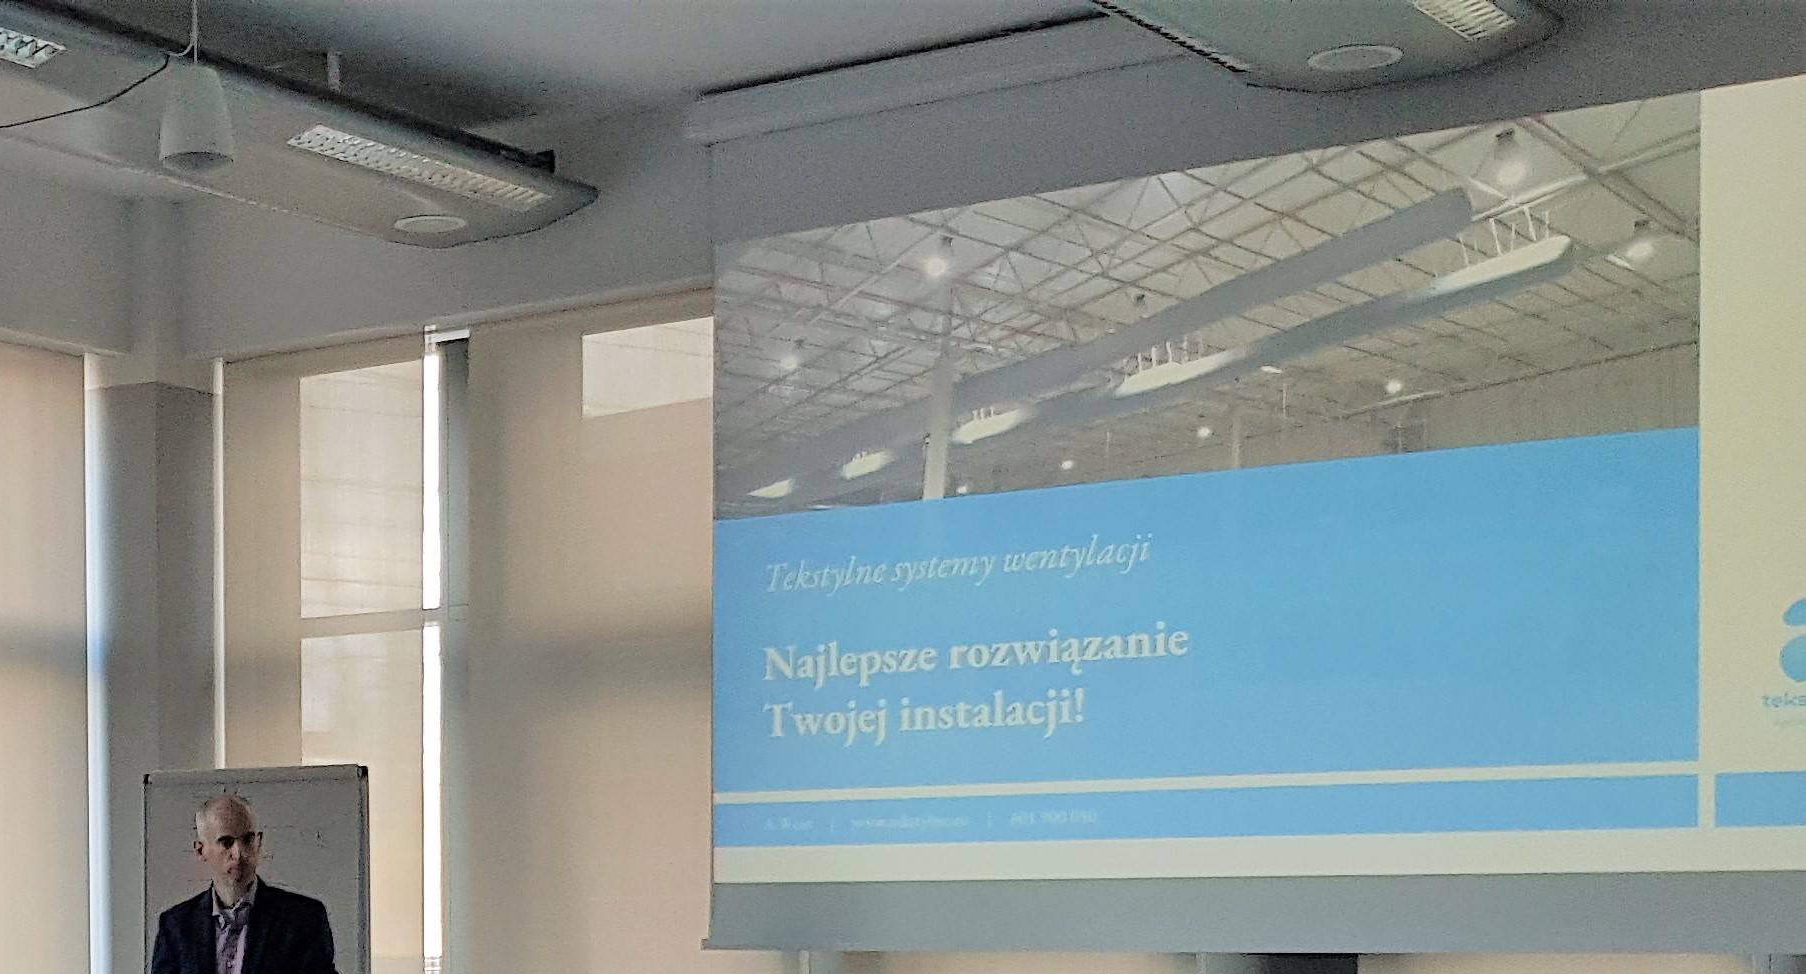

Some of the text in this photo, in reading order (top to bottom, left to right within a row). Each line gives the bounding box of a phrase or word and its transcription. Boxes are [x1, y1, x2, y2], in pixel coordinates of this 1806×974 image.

[766, 533, 1153, 598] Tekstylne systemy wentylacji
[763, 621, 1190, 688] Najlepsze rozwiązanie
[763, 688, 1085, 747] Twojej instalacji!
